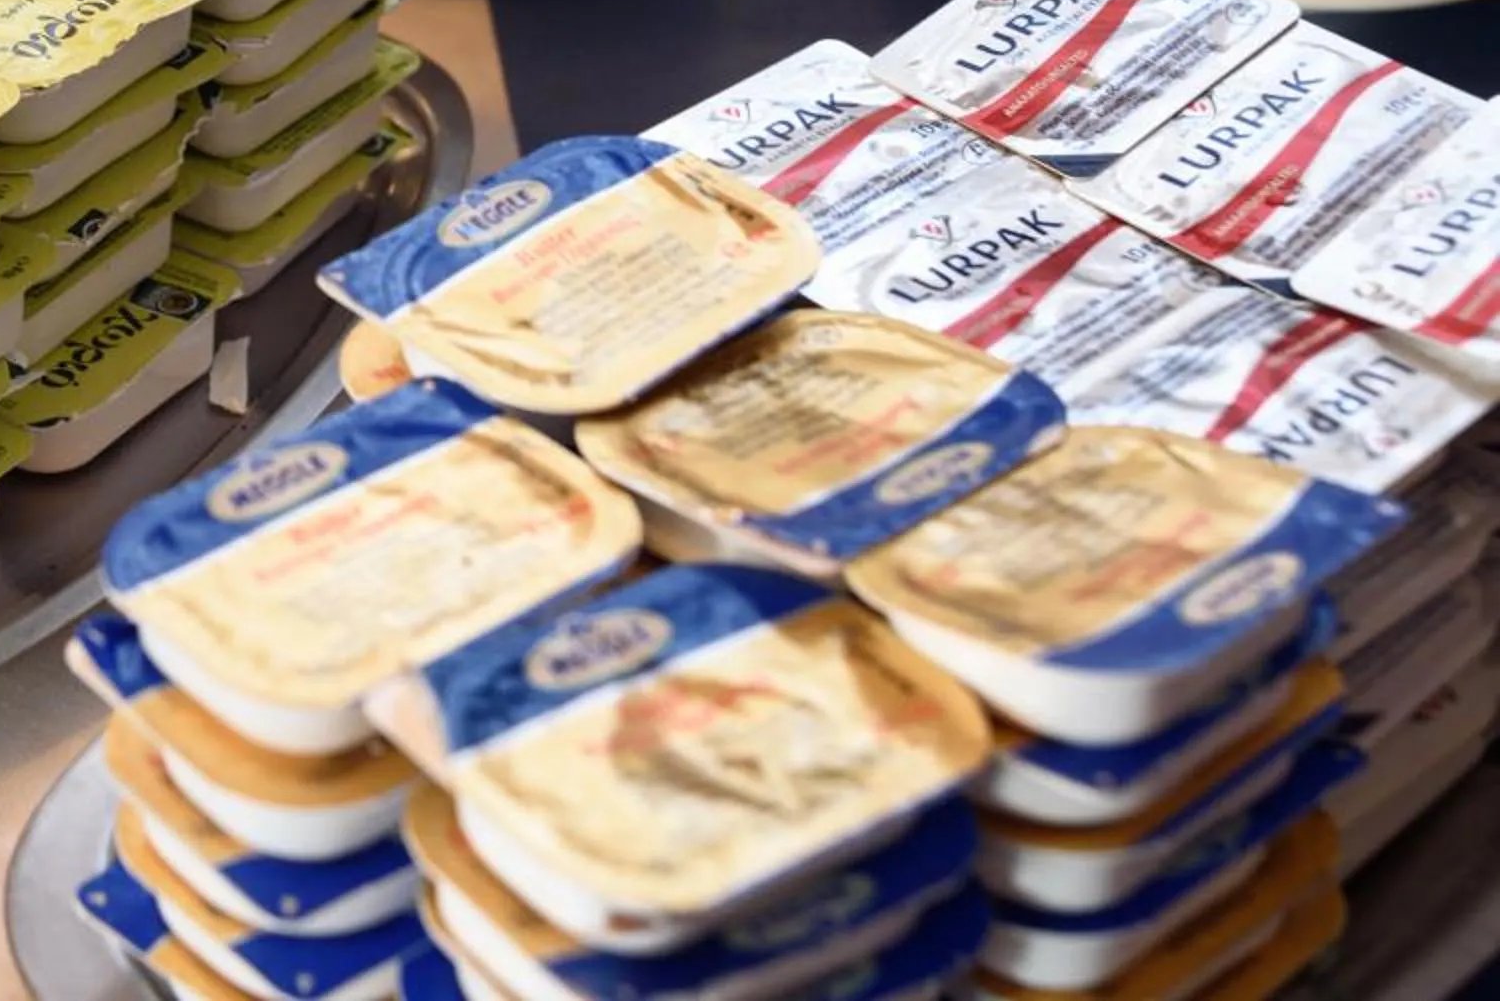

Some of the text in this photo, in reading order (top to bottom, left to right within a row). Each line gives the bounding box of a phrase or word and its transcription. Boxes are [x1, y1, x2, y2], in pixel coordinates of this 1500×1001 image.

[706, 91, 860, 174] URPAK
[1158, 69, 1326, 189] LURPAK
[887, 207, 1066, 306] LURPAK
[1391, 172, 1500, 279] LURP
